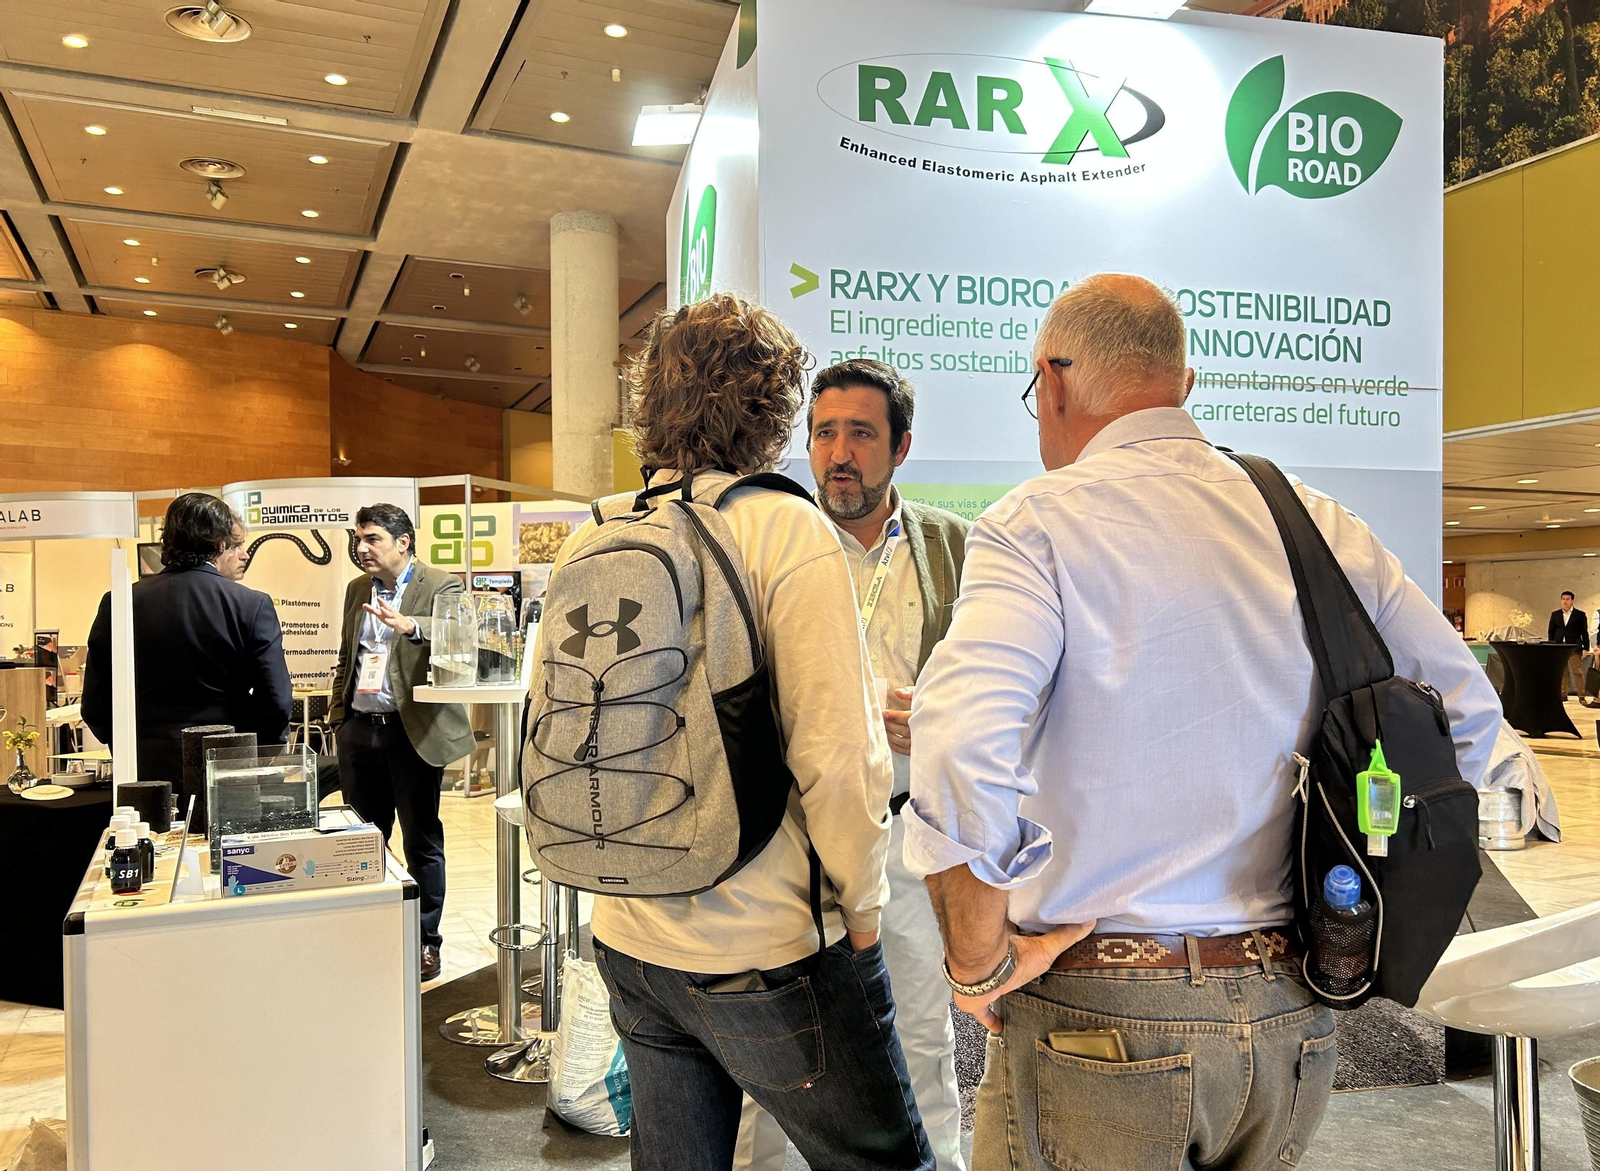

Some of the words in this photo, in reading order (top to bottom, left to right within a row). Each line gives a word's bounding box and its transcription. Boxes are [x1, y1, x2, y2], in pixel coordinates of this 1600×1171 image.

[1288, 112, 1363, 156] BIO
[839, 136, 917, 168] Enhanced
[922, 159, 1015, 182] Elastomeric
[1020, 171, 1077, 185] Asphalt
[1082, 163, 1146, 181] Extender
[1288, 158, 1362, 186] ROAD
[690, 225, 708, 304] BIO
[830, 268, 922, 303] RARX
[926, 273, 950, 303] Y
[957, 275, 1070, 309] BIORO
[1176, 288, 1392, 328] OSTENIBILIDAD
[830, 309, 852, 334] El
[859, 310, 994, 342] ingrediente
[1000, 316, 1028, 340] de
[930, 350, 1033, 374] sostenib
[1194, 366, 1316, 392] imentamos
[1321, 377, 1346, 394] en
[1351, 374, 1409, 397] verde
[1191, 401, 1298, 423] carreteras
[1302, 402, 1332, 425] del
[1337, 403, 1401, 427] futuro
[937, 500, 955, 509] sus
[957, 498, 977, 509] vías
[281, 598, 321, 608] Plastómeros
[281, 621, 320, 629] Promotores
[226, 846, 250, 855] sanyc
[118, 868, 139, 879] SB1
